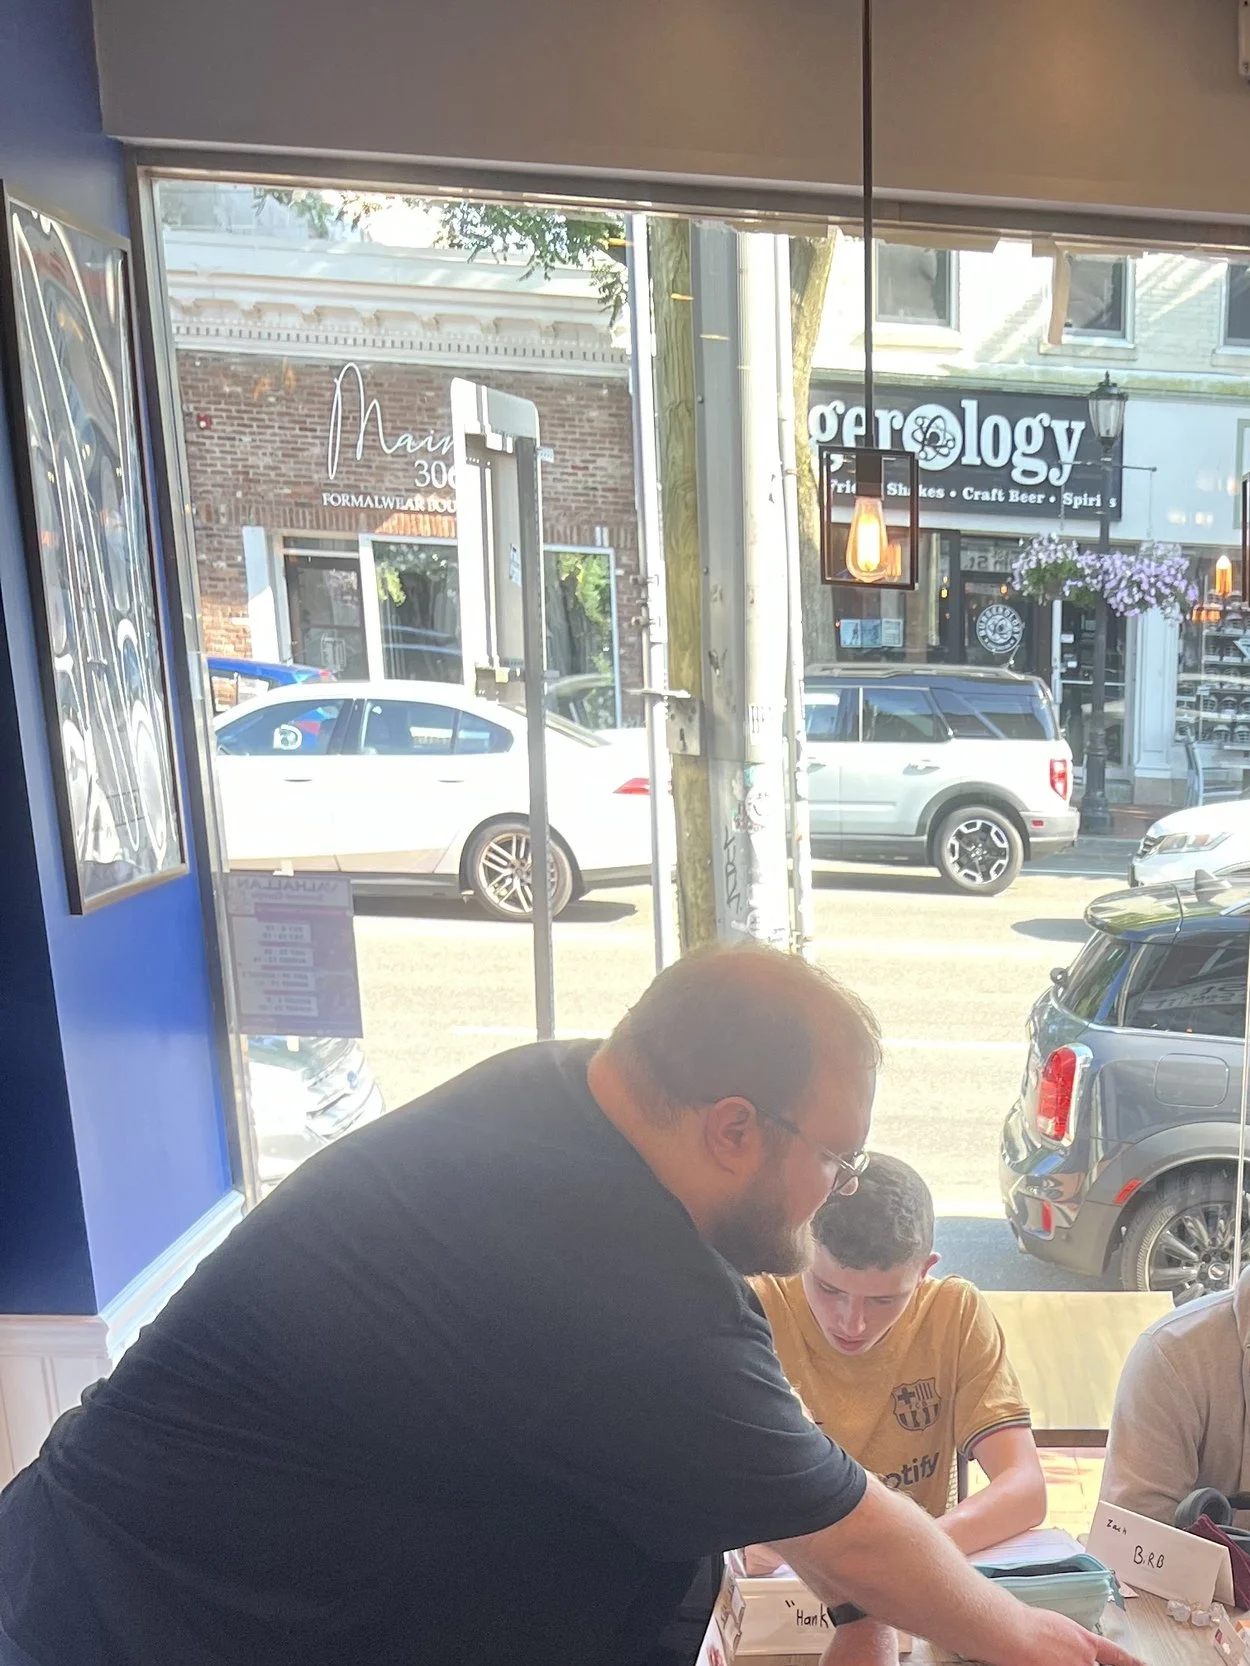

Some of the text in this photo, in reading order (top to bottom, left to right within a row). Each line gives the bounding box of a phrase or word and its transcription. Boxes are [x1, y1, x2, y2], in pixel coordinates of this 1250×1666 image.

[322, 492, 425, 512] FORMALWEAR
[887, 482, 945, 499] Shkes
[962, 487, 1005, 503] Craft
[1009, 489, 1046, 505] Beer
[1062, 493, 1118, 509] Spiris
